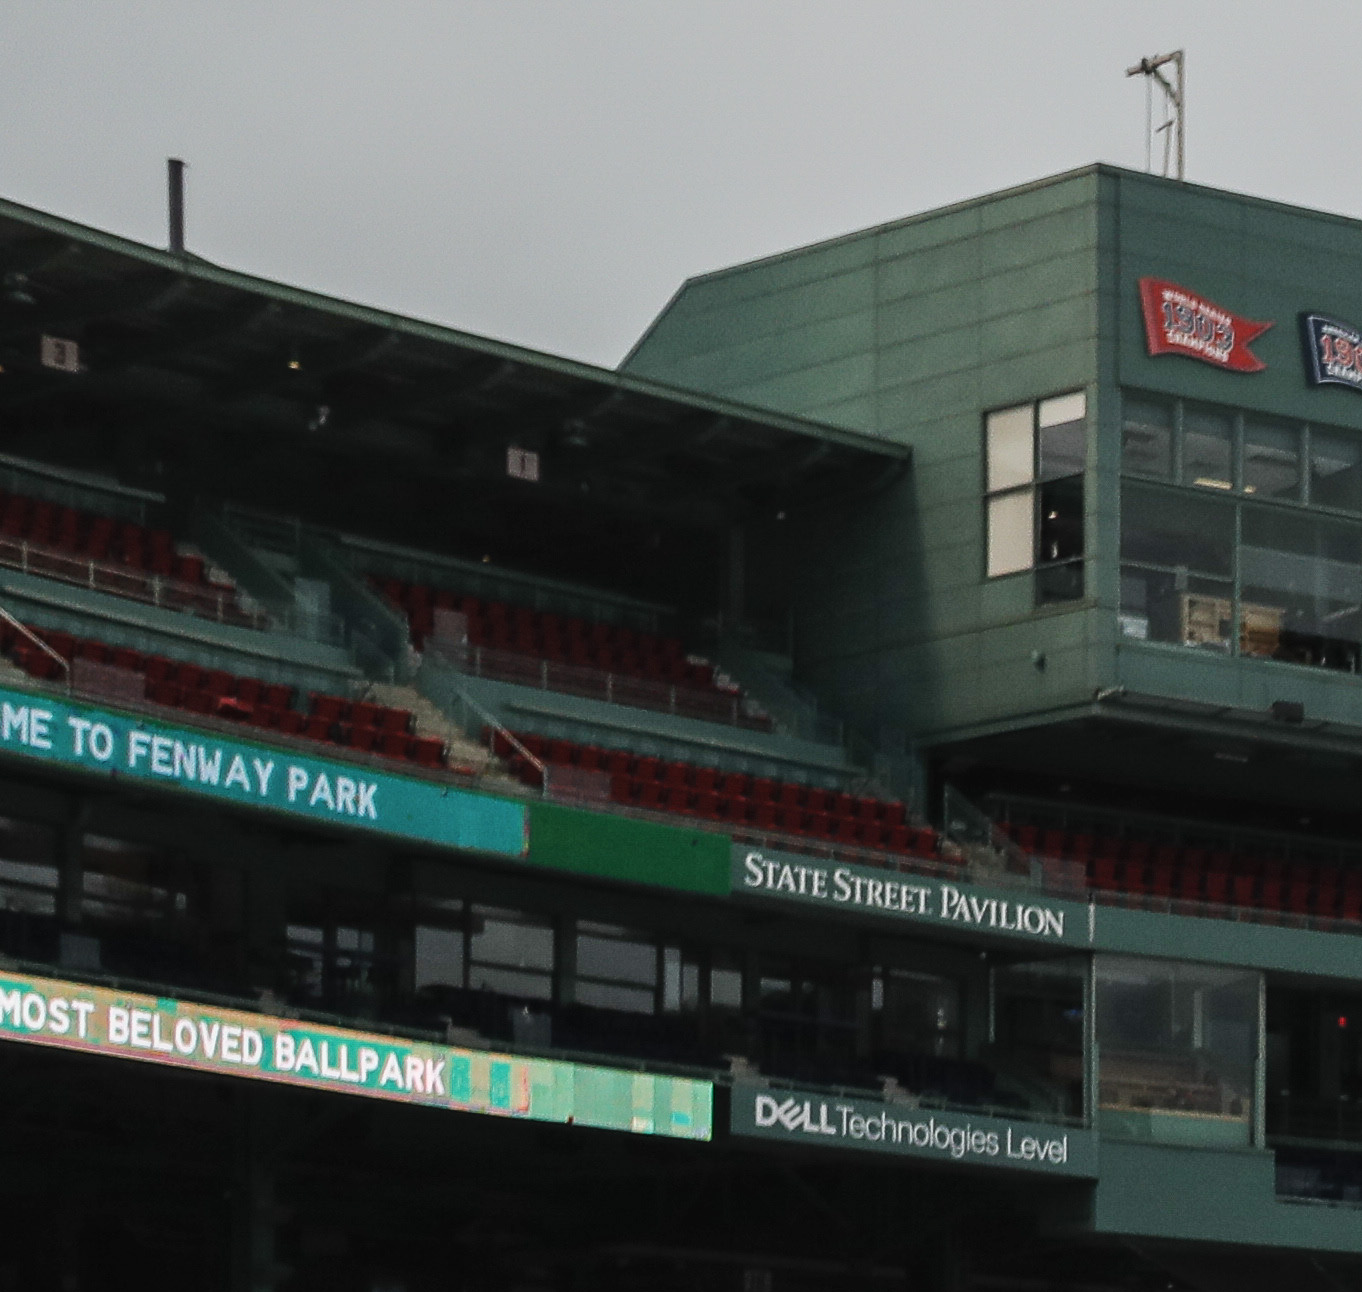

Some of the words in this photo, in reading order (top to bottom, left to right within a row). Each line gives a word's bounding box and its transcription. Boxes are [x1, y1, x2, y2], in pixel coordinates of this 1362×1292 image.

[1, 706, 53, 750] ME
[69, 717, 114, 761] TO
[128, 730, 275, 798] FENWAY
[288, 765, 378, 821] PARK
[744, 851, 827, 899] STATE
[832, 868, 932, 915] STREET
[940, 883, 1065, 938] PAVILION
[0, 989, 95, 1040] MOST
[107, 1006, 264, 1066] BELOVED
[275, 1033, 446, 1097] BALLPARK
[754, 1095, 836, 1136] DELL
[836, 1104, 999, 1160] Technologies
[1006, 1127, 1068, 1164] Level
